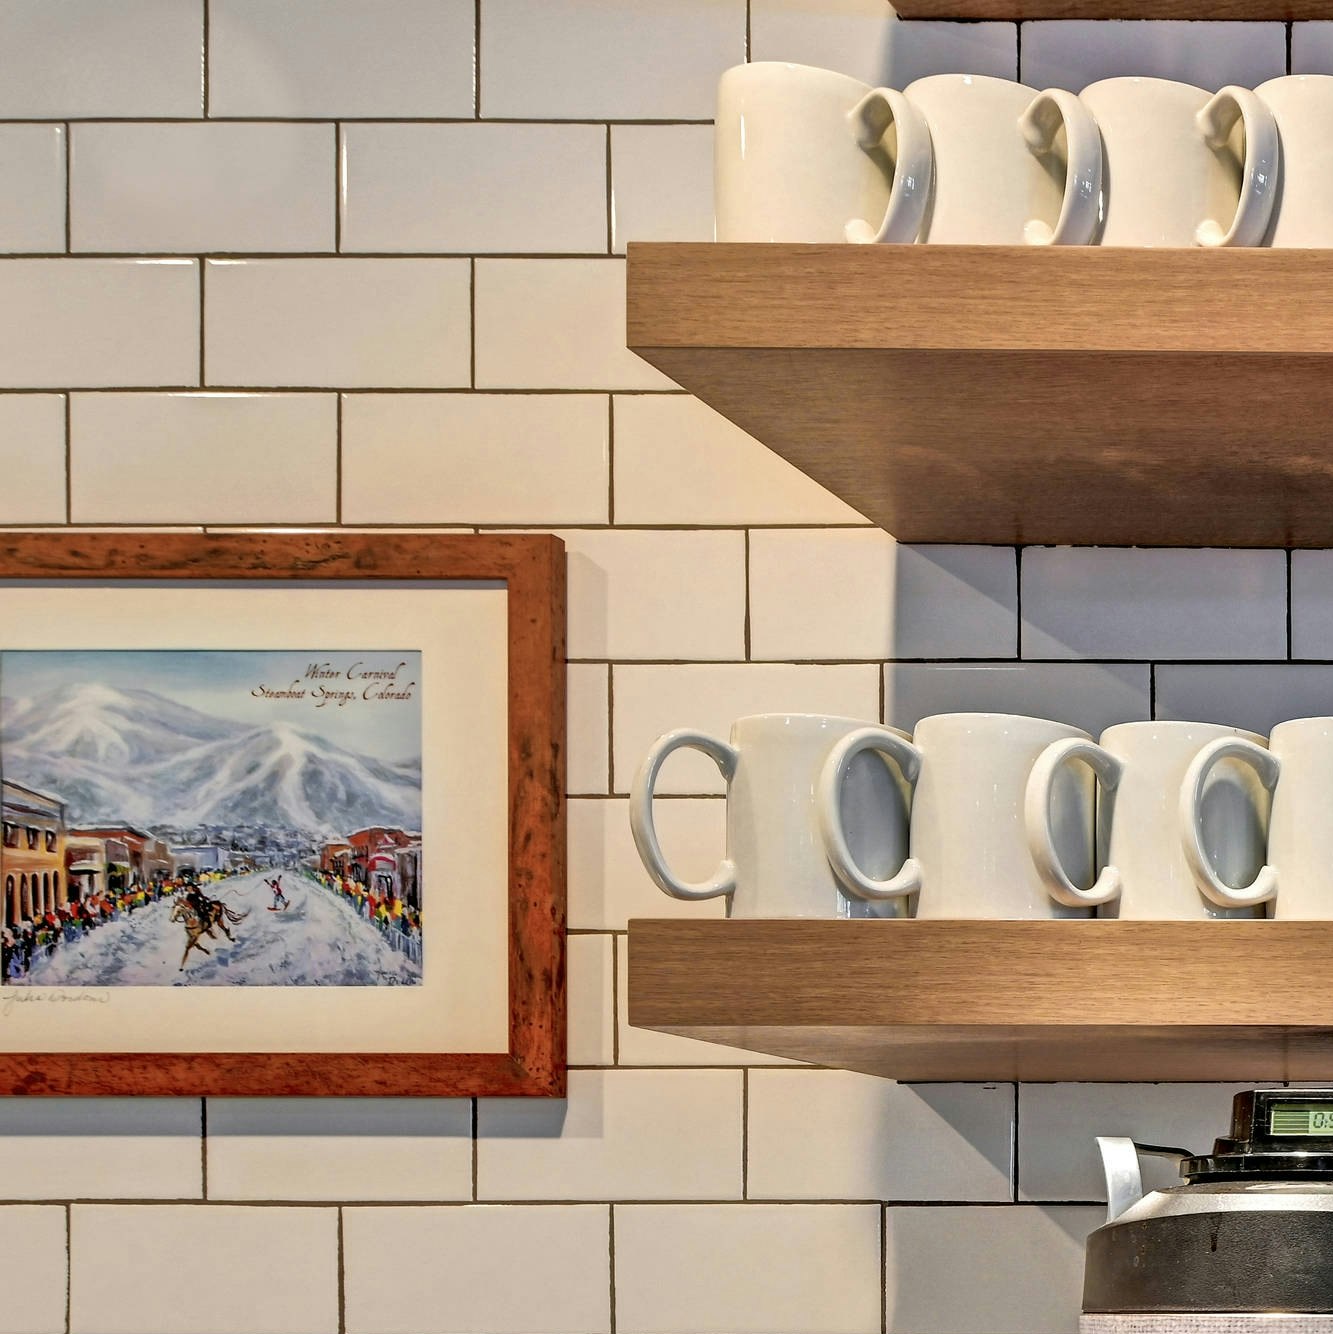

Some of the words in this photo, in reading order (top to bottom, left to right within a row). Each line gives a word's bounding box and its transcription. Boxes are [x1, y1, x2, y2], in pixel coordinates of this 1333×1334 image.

[305, 663, 341, 680] Winter
[346, 661, 406, 680] Carnival
[251, 679, 306, 699] Steamboat
[362, 681, 416, 700] Colorado
